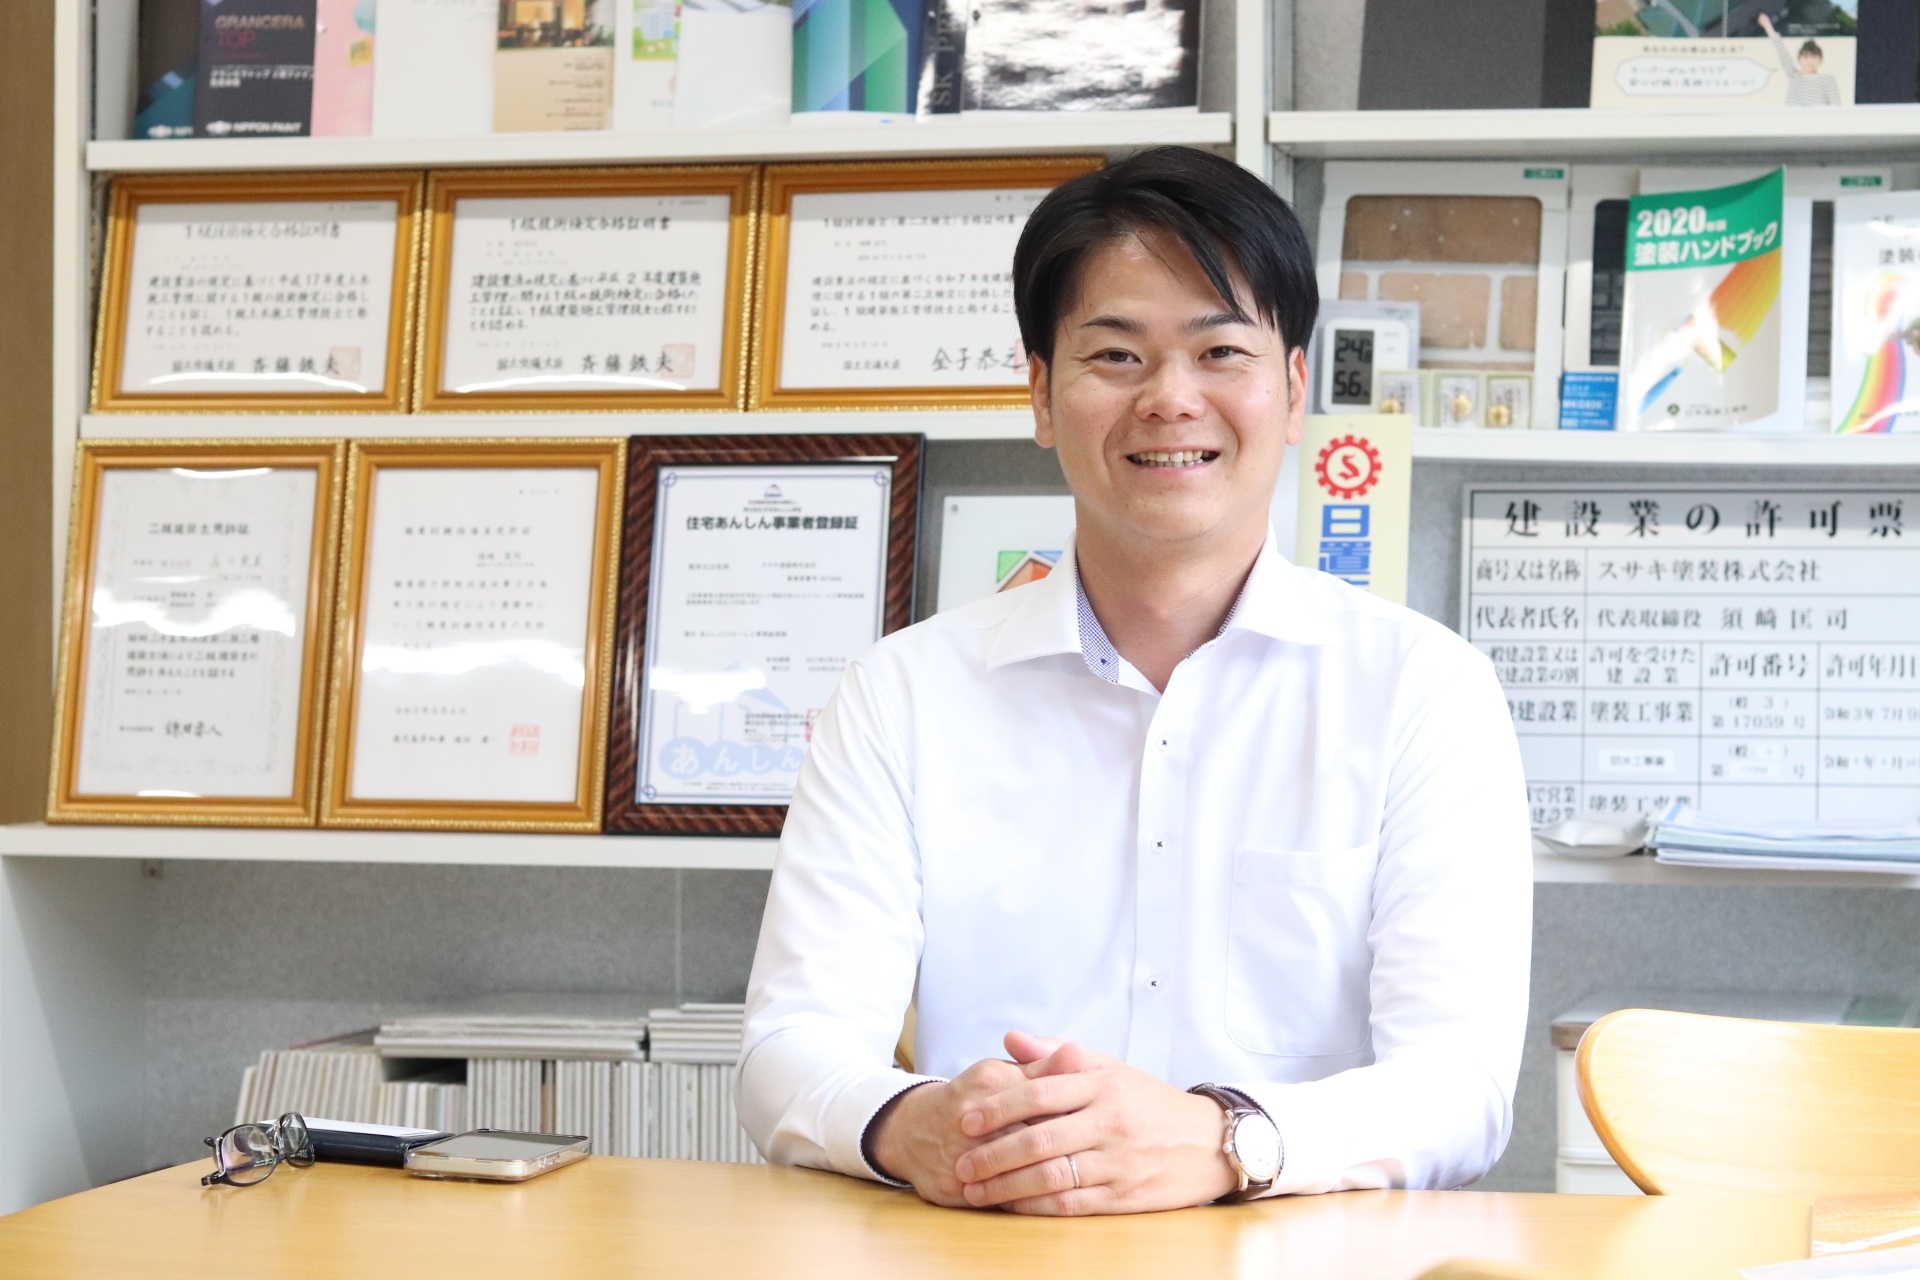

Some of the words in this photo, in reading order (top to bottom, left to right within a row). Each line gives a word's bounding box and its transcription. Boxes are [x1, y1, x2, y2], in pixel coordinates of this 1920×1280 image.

[219, 30, 256, 46] TOP
[509, 216, 672, 232] 1級技術検定合格証明書
[1634, 220, 1778, 266] 塗装ハンドブック
[686, 516, 858, 530] 住宅あんしん事業者登録証
[1505, 499, 1903, 537] 建設業の許可票
[1319, 504, 1371, 586] 日置
[1476, 557, 1581, 581] 商号又は名称
[1598, 558, 1821, 583] スサキ塗装株式会社
[1475, 605, 1580, 629] 代表者氏名
[1597, 607, 1702, 629] 代表取締役
[1589, 647, 1696, 663] 許可を受けた
[1710, 653, 1806, 677] 許可番号
[1607, 667, 1679, 684] 建設業
[1590, 700, 1694, 723] 塗装工事業
